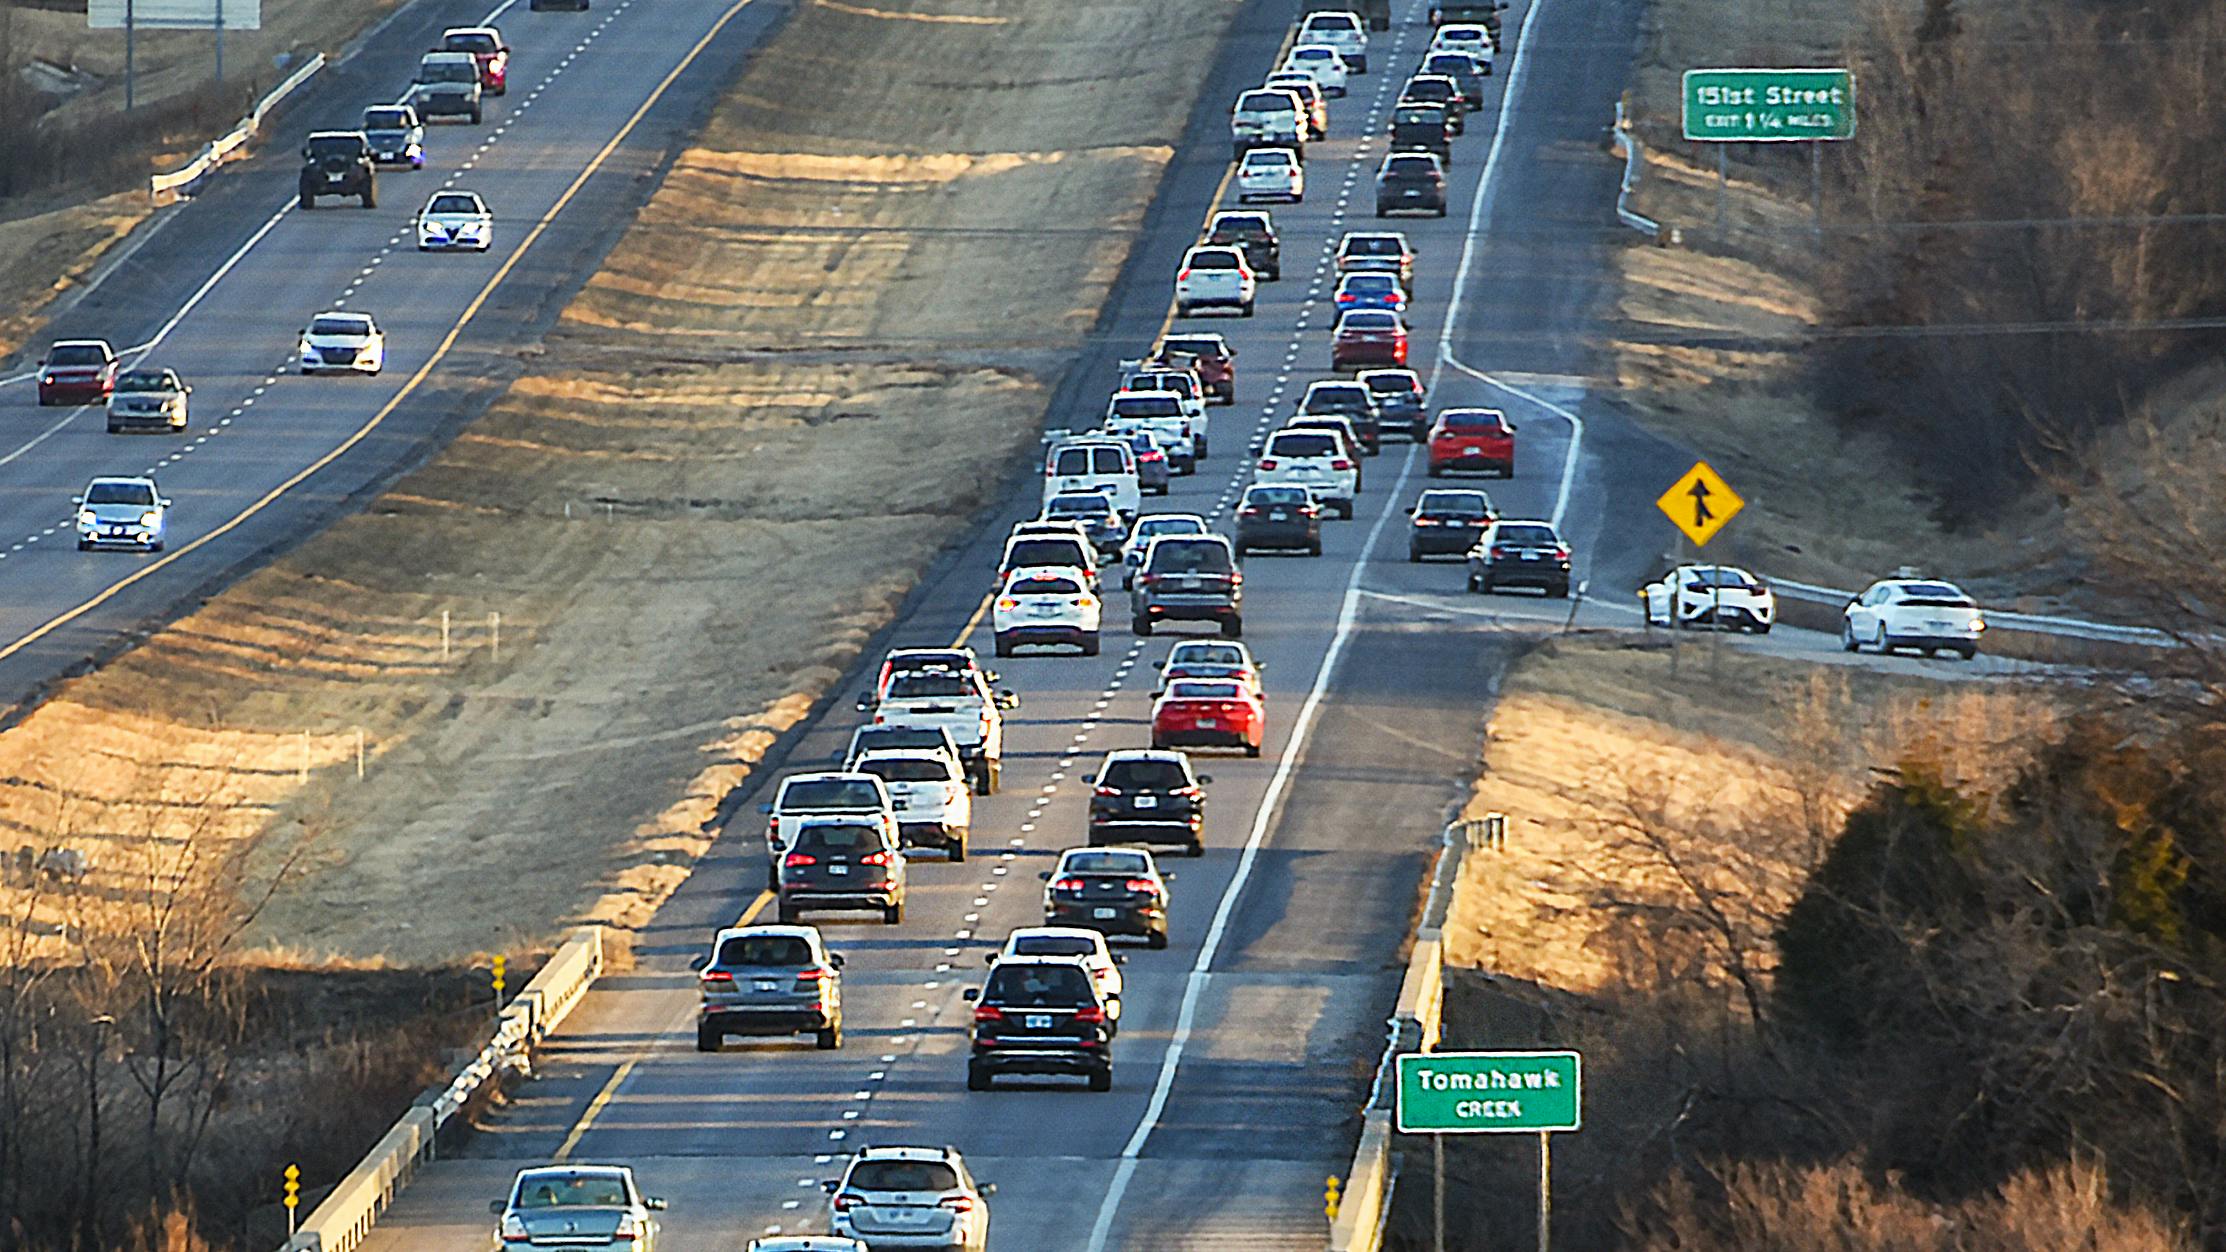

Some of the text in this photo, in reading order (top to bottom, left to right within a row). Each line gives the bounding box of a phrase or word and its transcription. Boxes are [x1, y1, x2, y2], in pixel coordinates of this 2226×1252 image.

[1697, 86, 1843, 105] 151st Street
[1417, 1069, 1561, 1090] Tomahawk
[1455, 1100, 1521, 1118] CREEK
